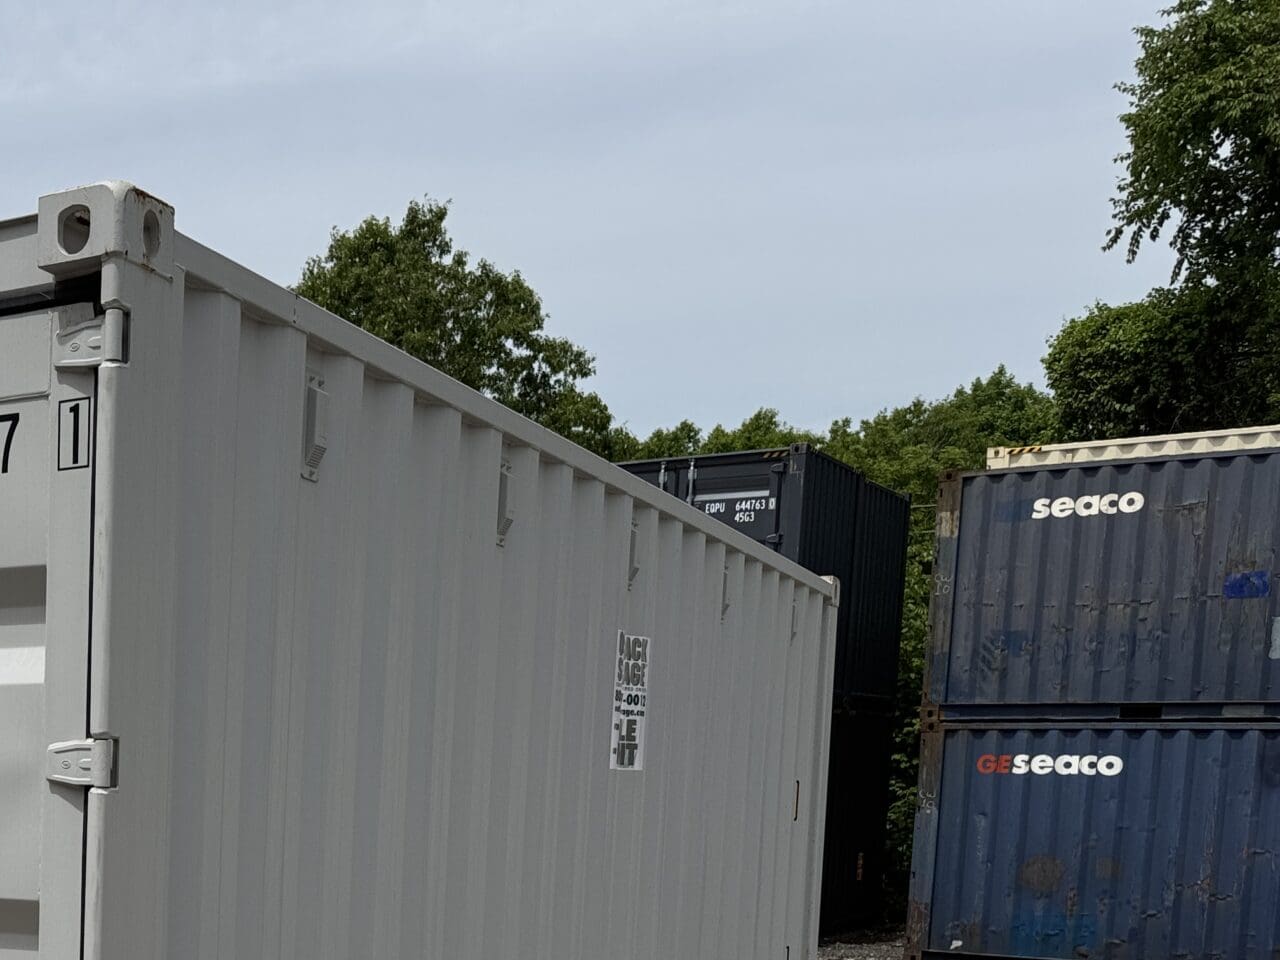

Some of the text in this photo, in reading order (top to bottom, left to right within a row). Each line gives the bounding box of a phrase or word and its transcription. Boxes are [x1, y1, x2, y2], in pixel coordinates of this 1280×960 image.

[735, 499, 766, 511] 644763
[1031, 491, 1145, 519] seaco
[734, 511, 755, 522] 45G3
